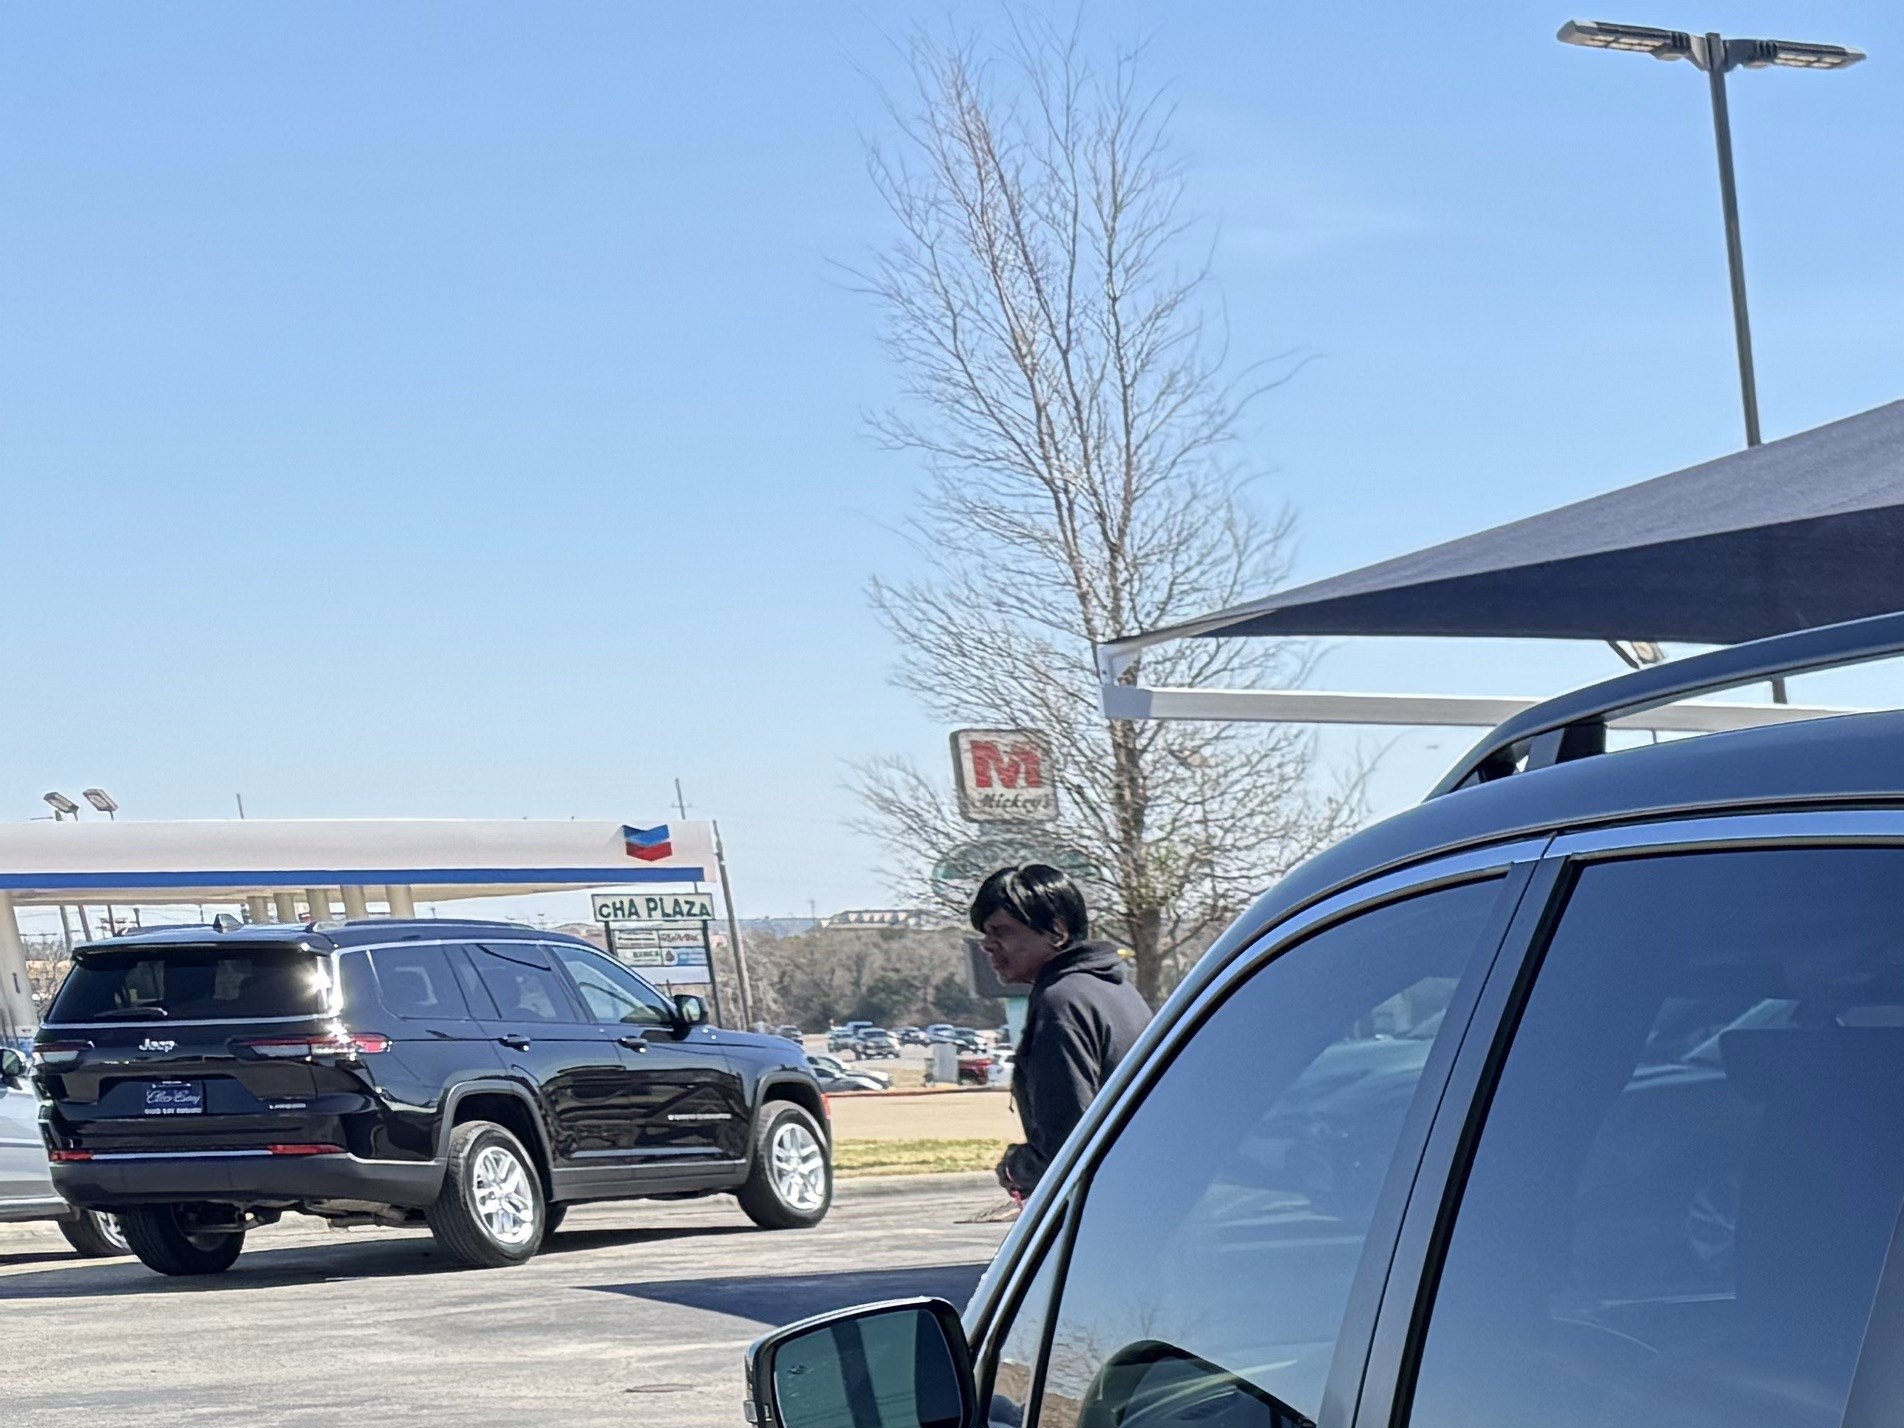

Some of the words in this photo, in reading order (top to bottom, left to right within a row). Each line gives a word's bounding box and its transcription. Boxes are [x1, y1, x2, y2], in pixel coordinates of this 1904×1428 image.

[970, 740, 1042, 789] M
[598, 898, 641, 919] CHA
[645, 897, 711, 918] PLAZA
[138, 1038, 176, 1052] Jeep
